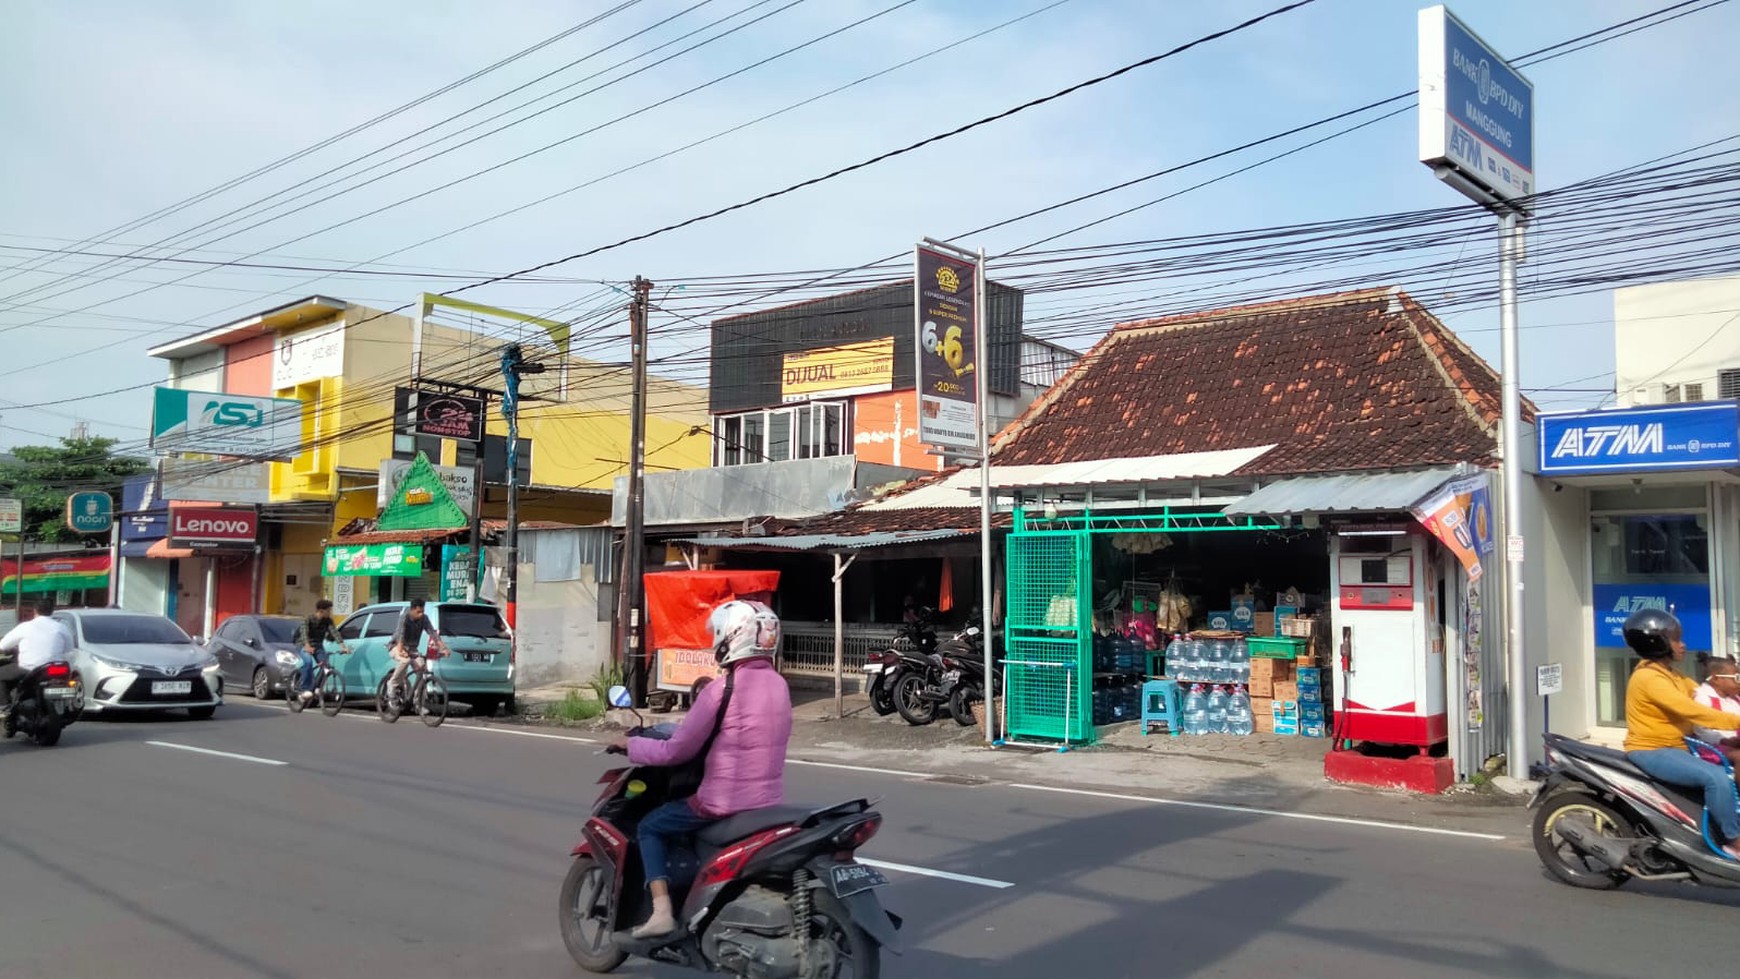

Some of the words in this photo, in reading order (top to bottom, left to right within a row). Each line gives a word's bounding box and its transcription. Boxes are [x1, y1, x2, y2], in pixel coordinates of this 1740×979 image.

[1453, 48, 1478, 85] BANK
[1490, 80, 1508, 108] BPD
[1508, 97, 1525, 120] DIY
[1466, 101, 1512, 149] MANGGUNG
[1449, 124, 1483, 172] ATM
[786, 364, 836, 385] DIJUAL
[422, 425, 471, 437] NONSTOP
[1551, 423, 1663, 458] ATM
[77, 515, 107, 524] noon
[176, 516, 249, 533] Lenovo
[446, 571, 470, 580] MUR
[450, 580, 468, 589] ENA
[1613, 596, 1667, 613] ATM
